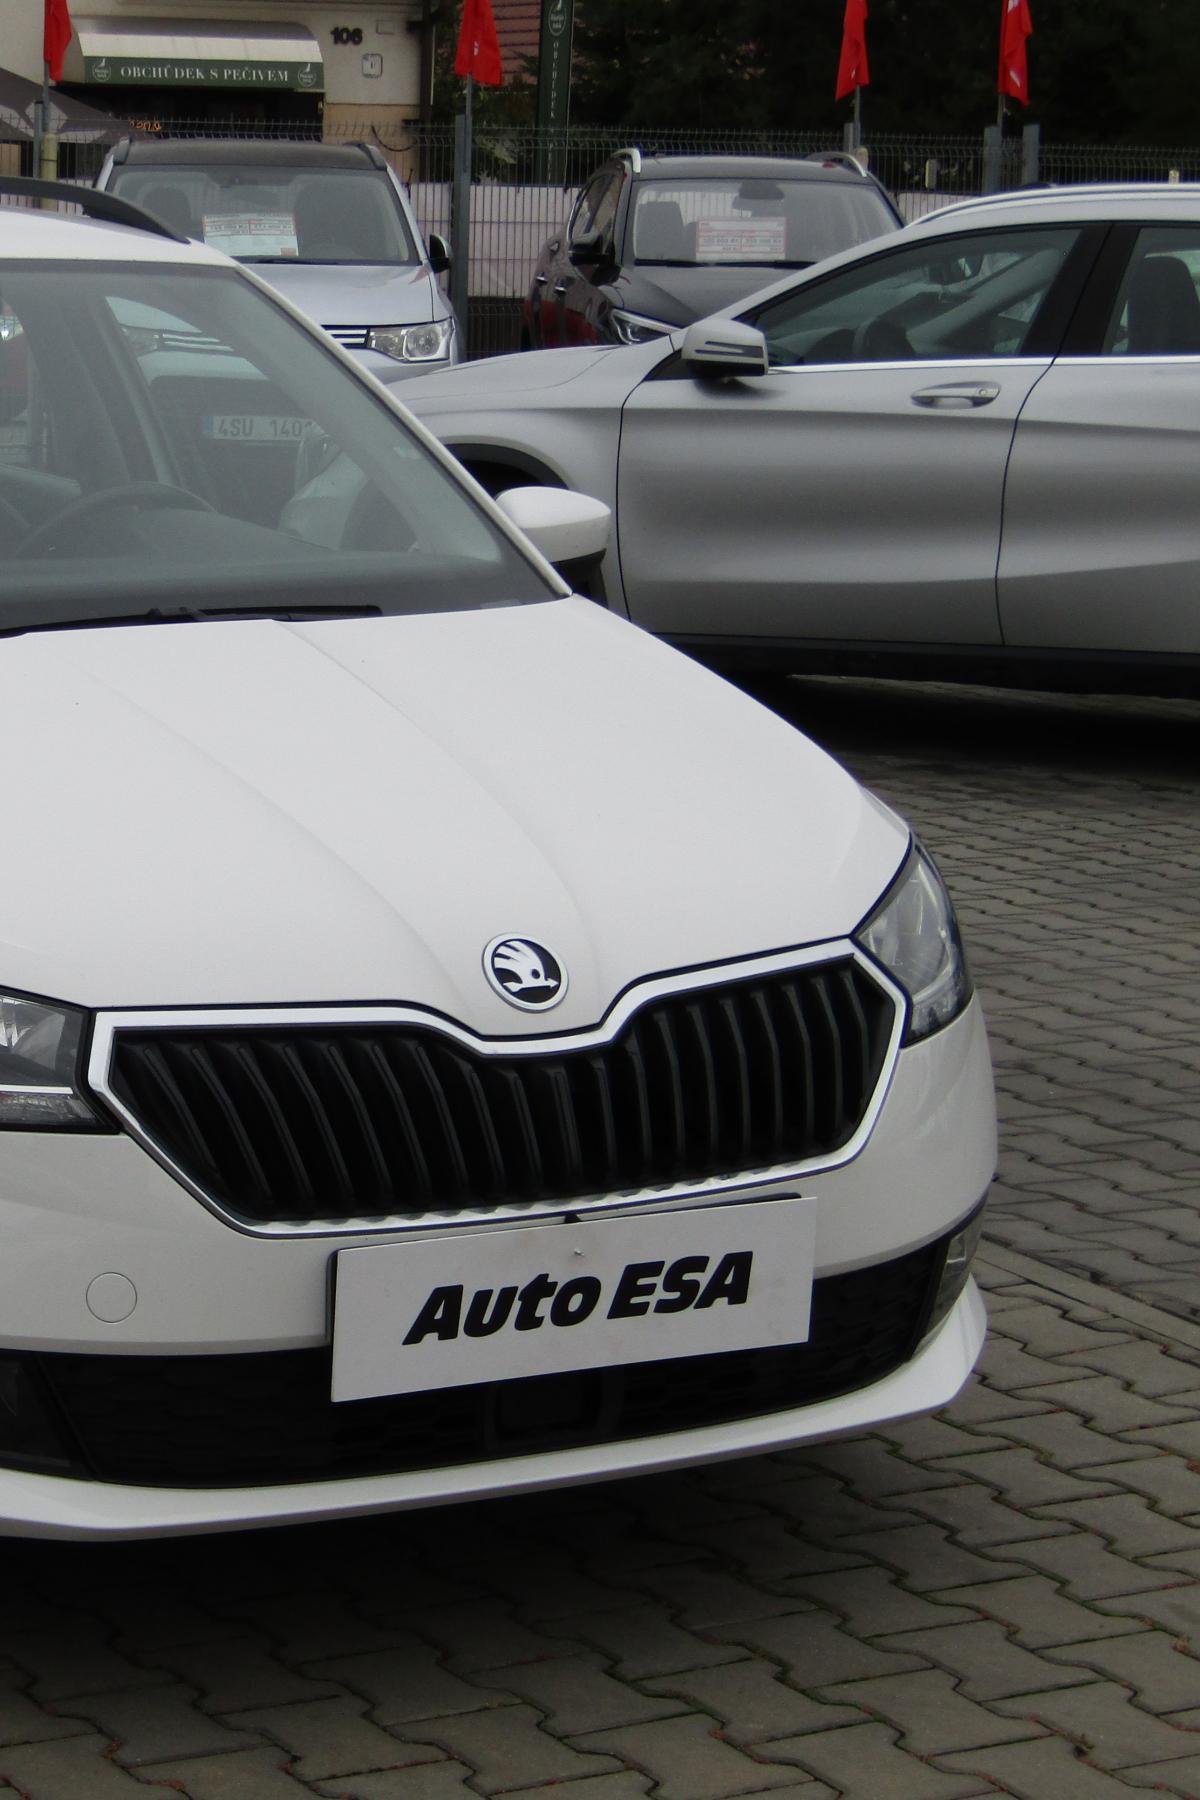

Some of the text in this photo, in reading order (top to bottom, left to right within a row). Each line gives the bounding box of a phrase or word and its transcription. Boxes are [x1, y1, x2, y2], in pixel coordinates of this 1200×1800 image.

[120, 64, 205, 80] OBCHŮDEK
[209, 68, 219, 80] S
[223, 66, 289, 82] PEČIVEM
[218, 418, 254, 437] 4SU
[401, 1251, 754, 1346] Auto ESA
